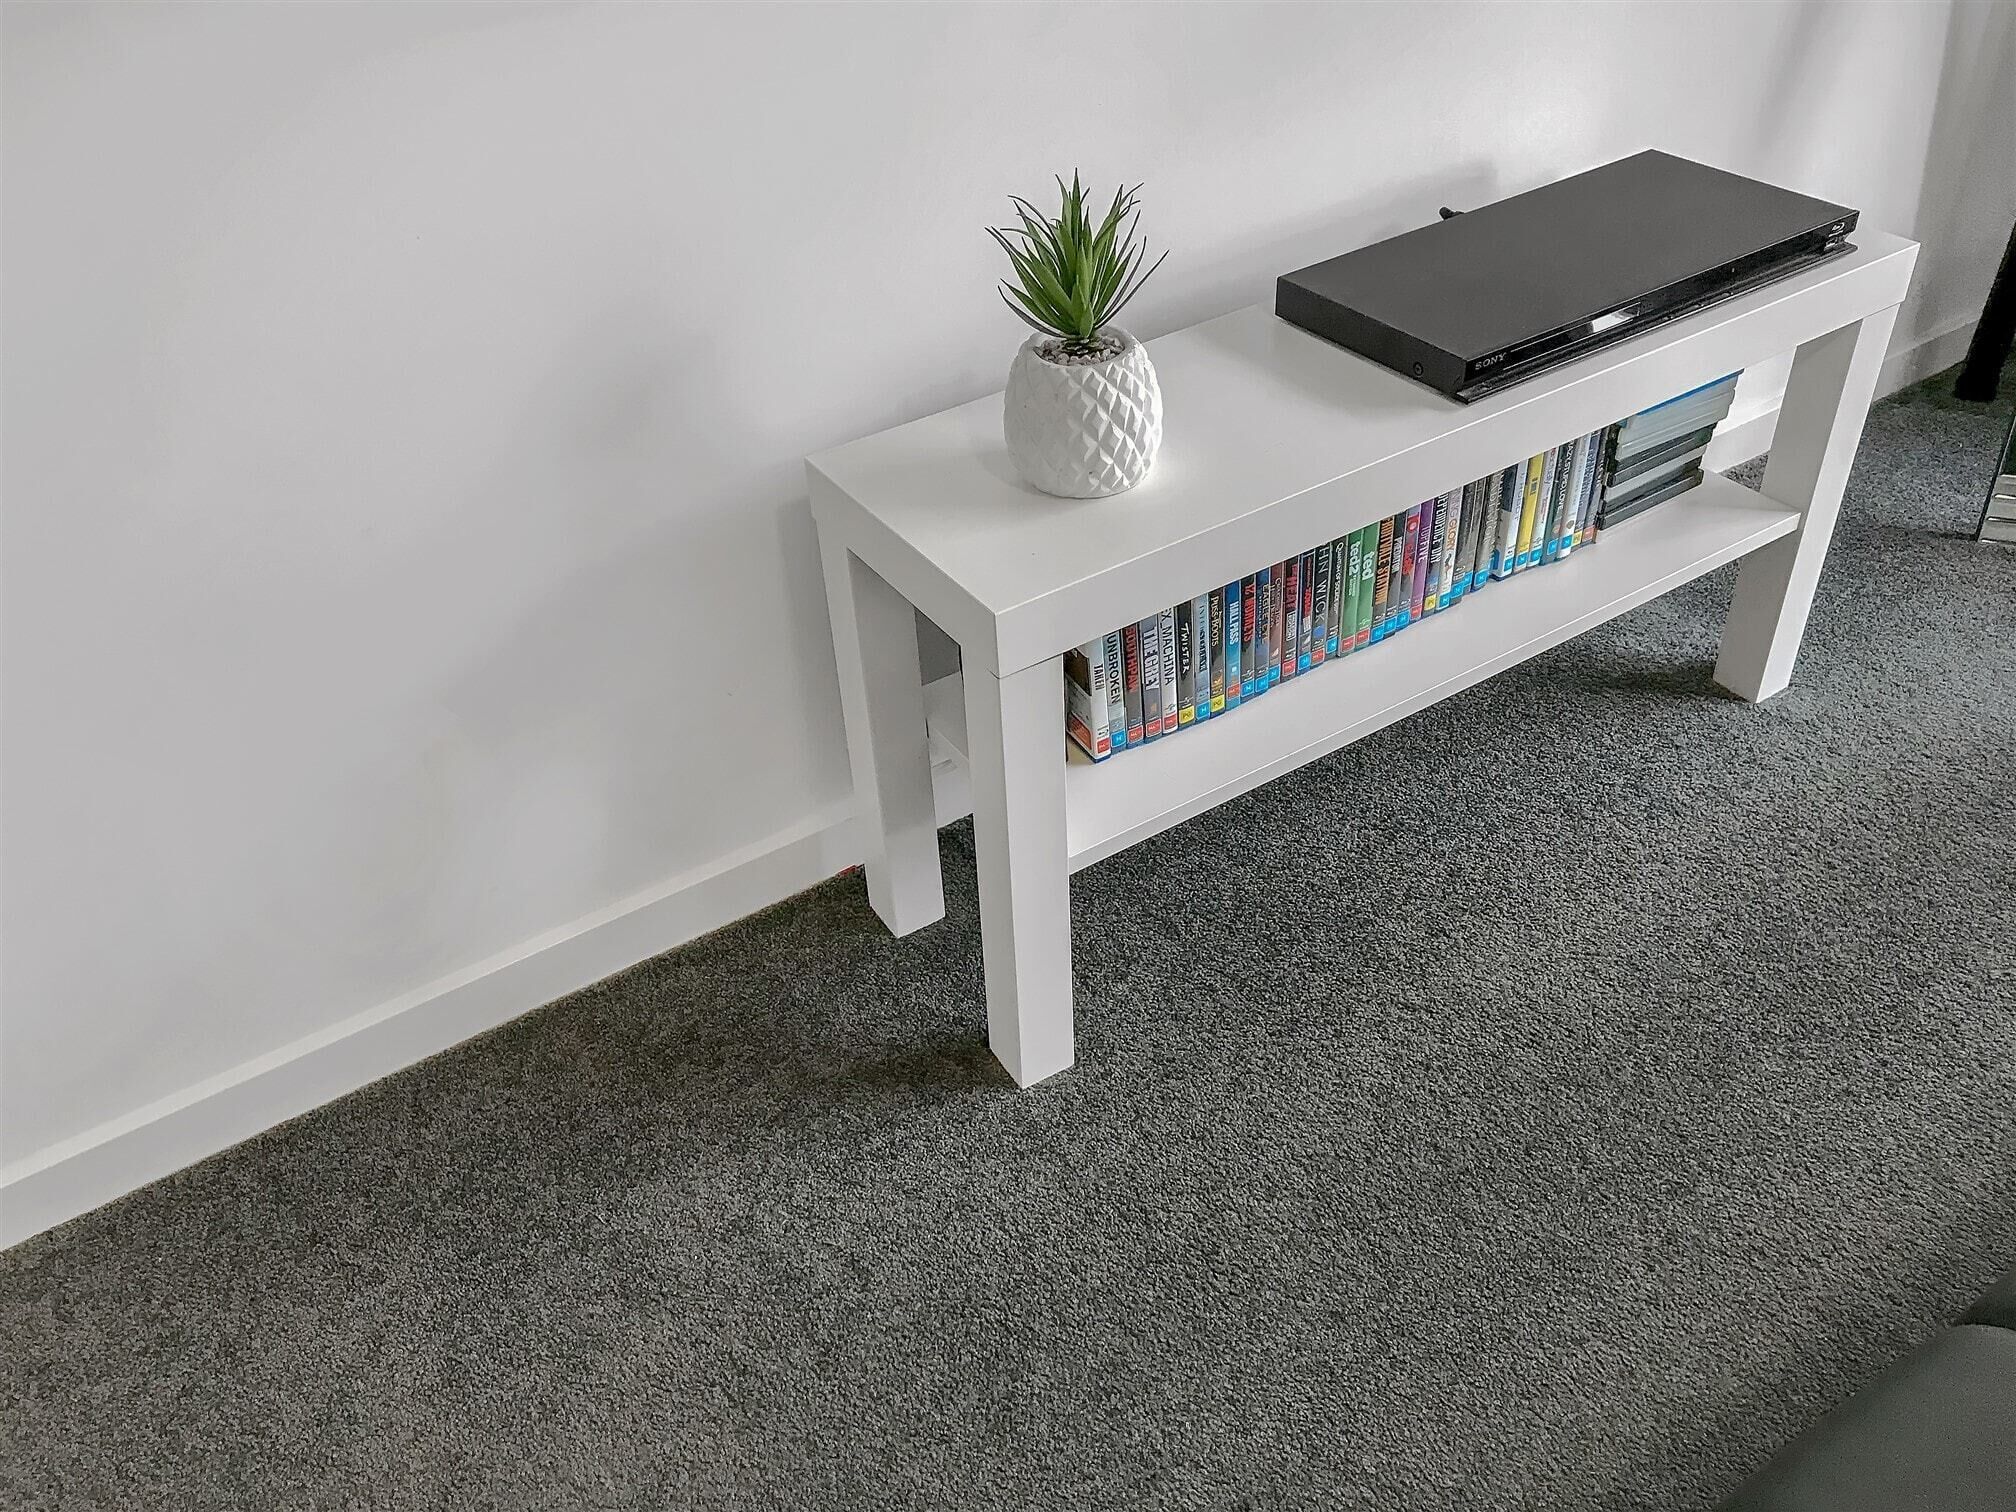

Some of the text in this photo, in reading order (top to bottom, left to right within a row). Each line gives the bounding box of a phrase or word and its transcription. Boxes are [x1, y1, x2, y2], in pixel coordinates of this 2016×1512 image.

[1475, 352, 1507, 370] SONY
[1361, 551, 1375, 580] ted
[1418, 541, 1429, 563] FIVE
[1430, 546, 1443, 563] DAY
[1314, 579, 1327, 623] WICK
[1229, 601, 1240, 645] HALL PASS
[1143, 626, 1160, 691] THE GREY
[1180, 622, 1191, 674] TWISTER
[1093, 663, 1105, 690] TAKEN
[1106, 634, 1121, 704] UNBROKEN
